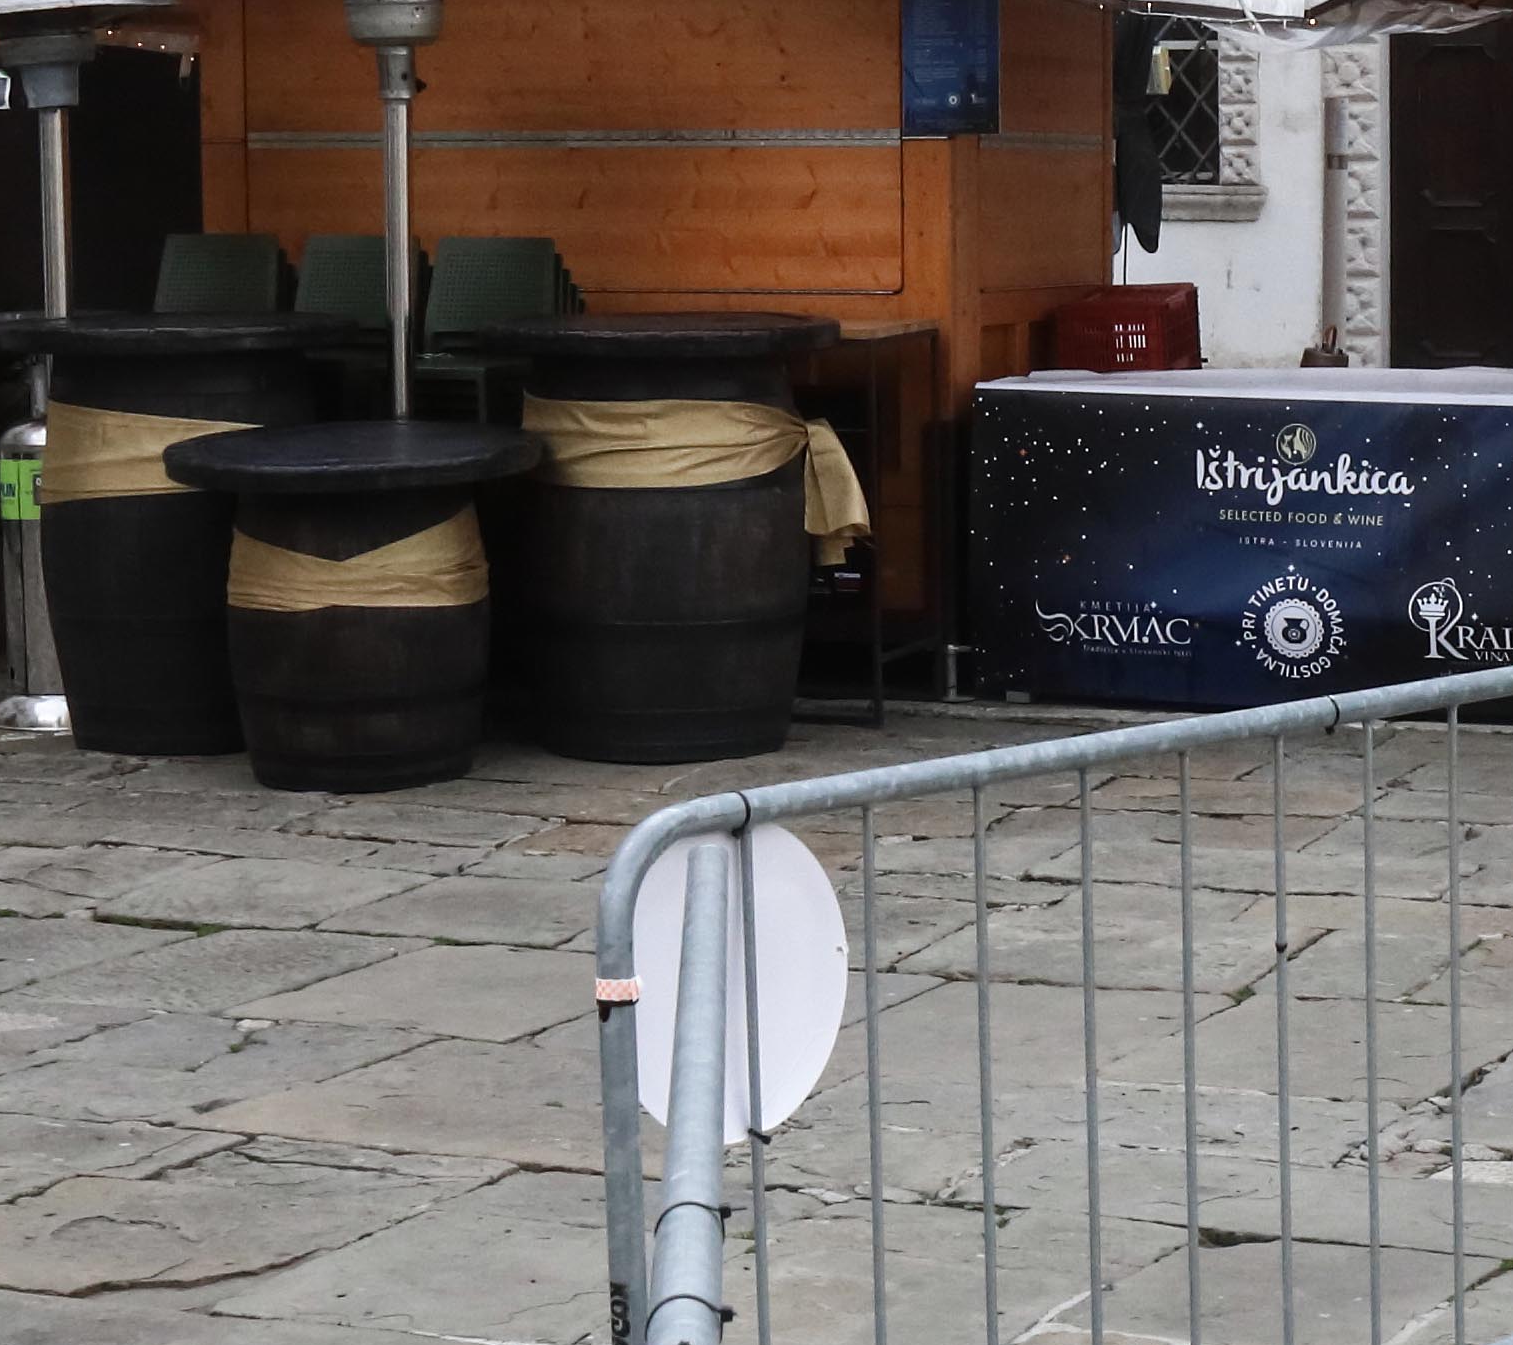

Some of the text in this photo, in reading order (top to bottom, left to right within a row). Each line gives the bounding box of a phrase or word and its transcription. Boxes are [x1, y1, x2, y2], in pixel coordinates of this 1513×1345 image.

[1195, 446, 1416, 506] Ištrijankica
[1218, 508, 1385, 527] SELECTED FOOD & WINE
[1239, 537, 1275, 546] ISTRA
[1295, 538, 1363, 550] SLOVENIJA
[1079, 600, 1151, 613] KMETIJA
[1241, 575, 1310, 641] PRI TINETU
[1255, 587, 1347, 679] DOMAČA GOSTILNA
[1474, 650, 1511, 662] VINA
